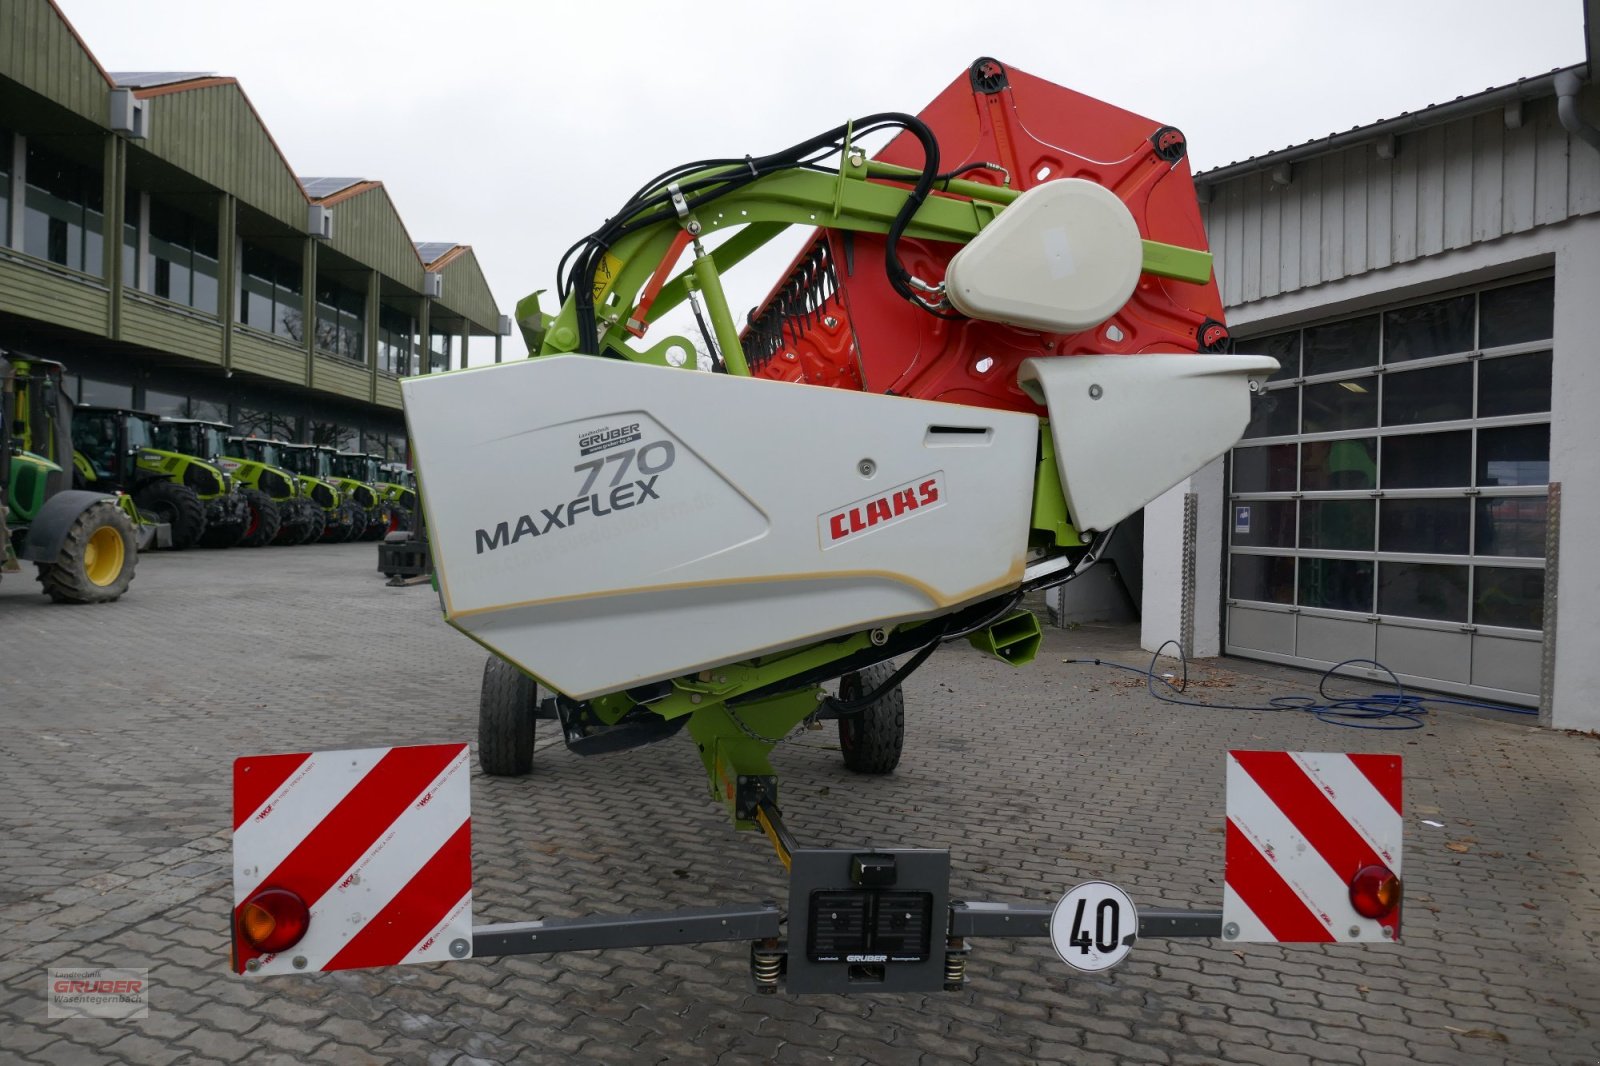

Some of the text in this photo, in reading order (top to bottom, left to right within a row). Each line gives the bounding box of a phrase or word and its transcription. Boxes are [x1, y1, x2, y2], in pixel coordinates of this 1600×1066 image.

[579, 423, 640, 448] GRUBER
[574, 440, 676, 497] 770
[475, 475, 661, 555] MAXFLEX
[830, 478, 939, 541] CLAAS
[419, 792, 432, 806] WGF
[258, 804, 273, 819] WGF
[341, 873, 355, 888] WGF
[1069, 897, 1120, 955] 40
[421, 936, 435, 950] WGF
[846, 954, 888, 962] GRUBER
